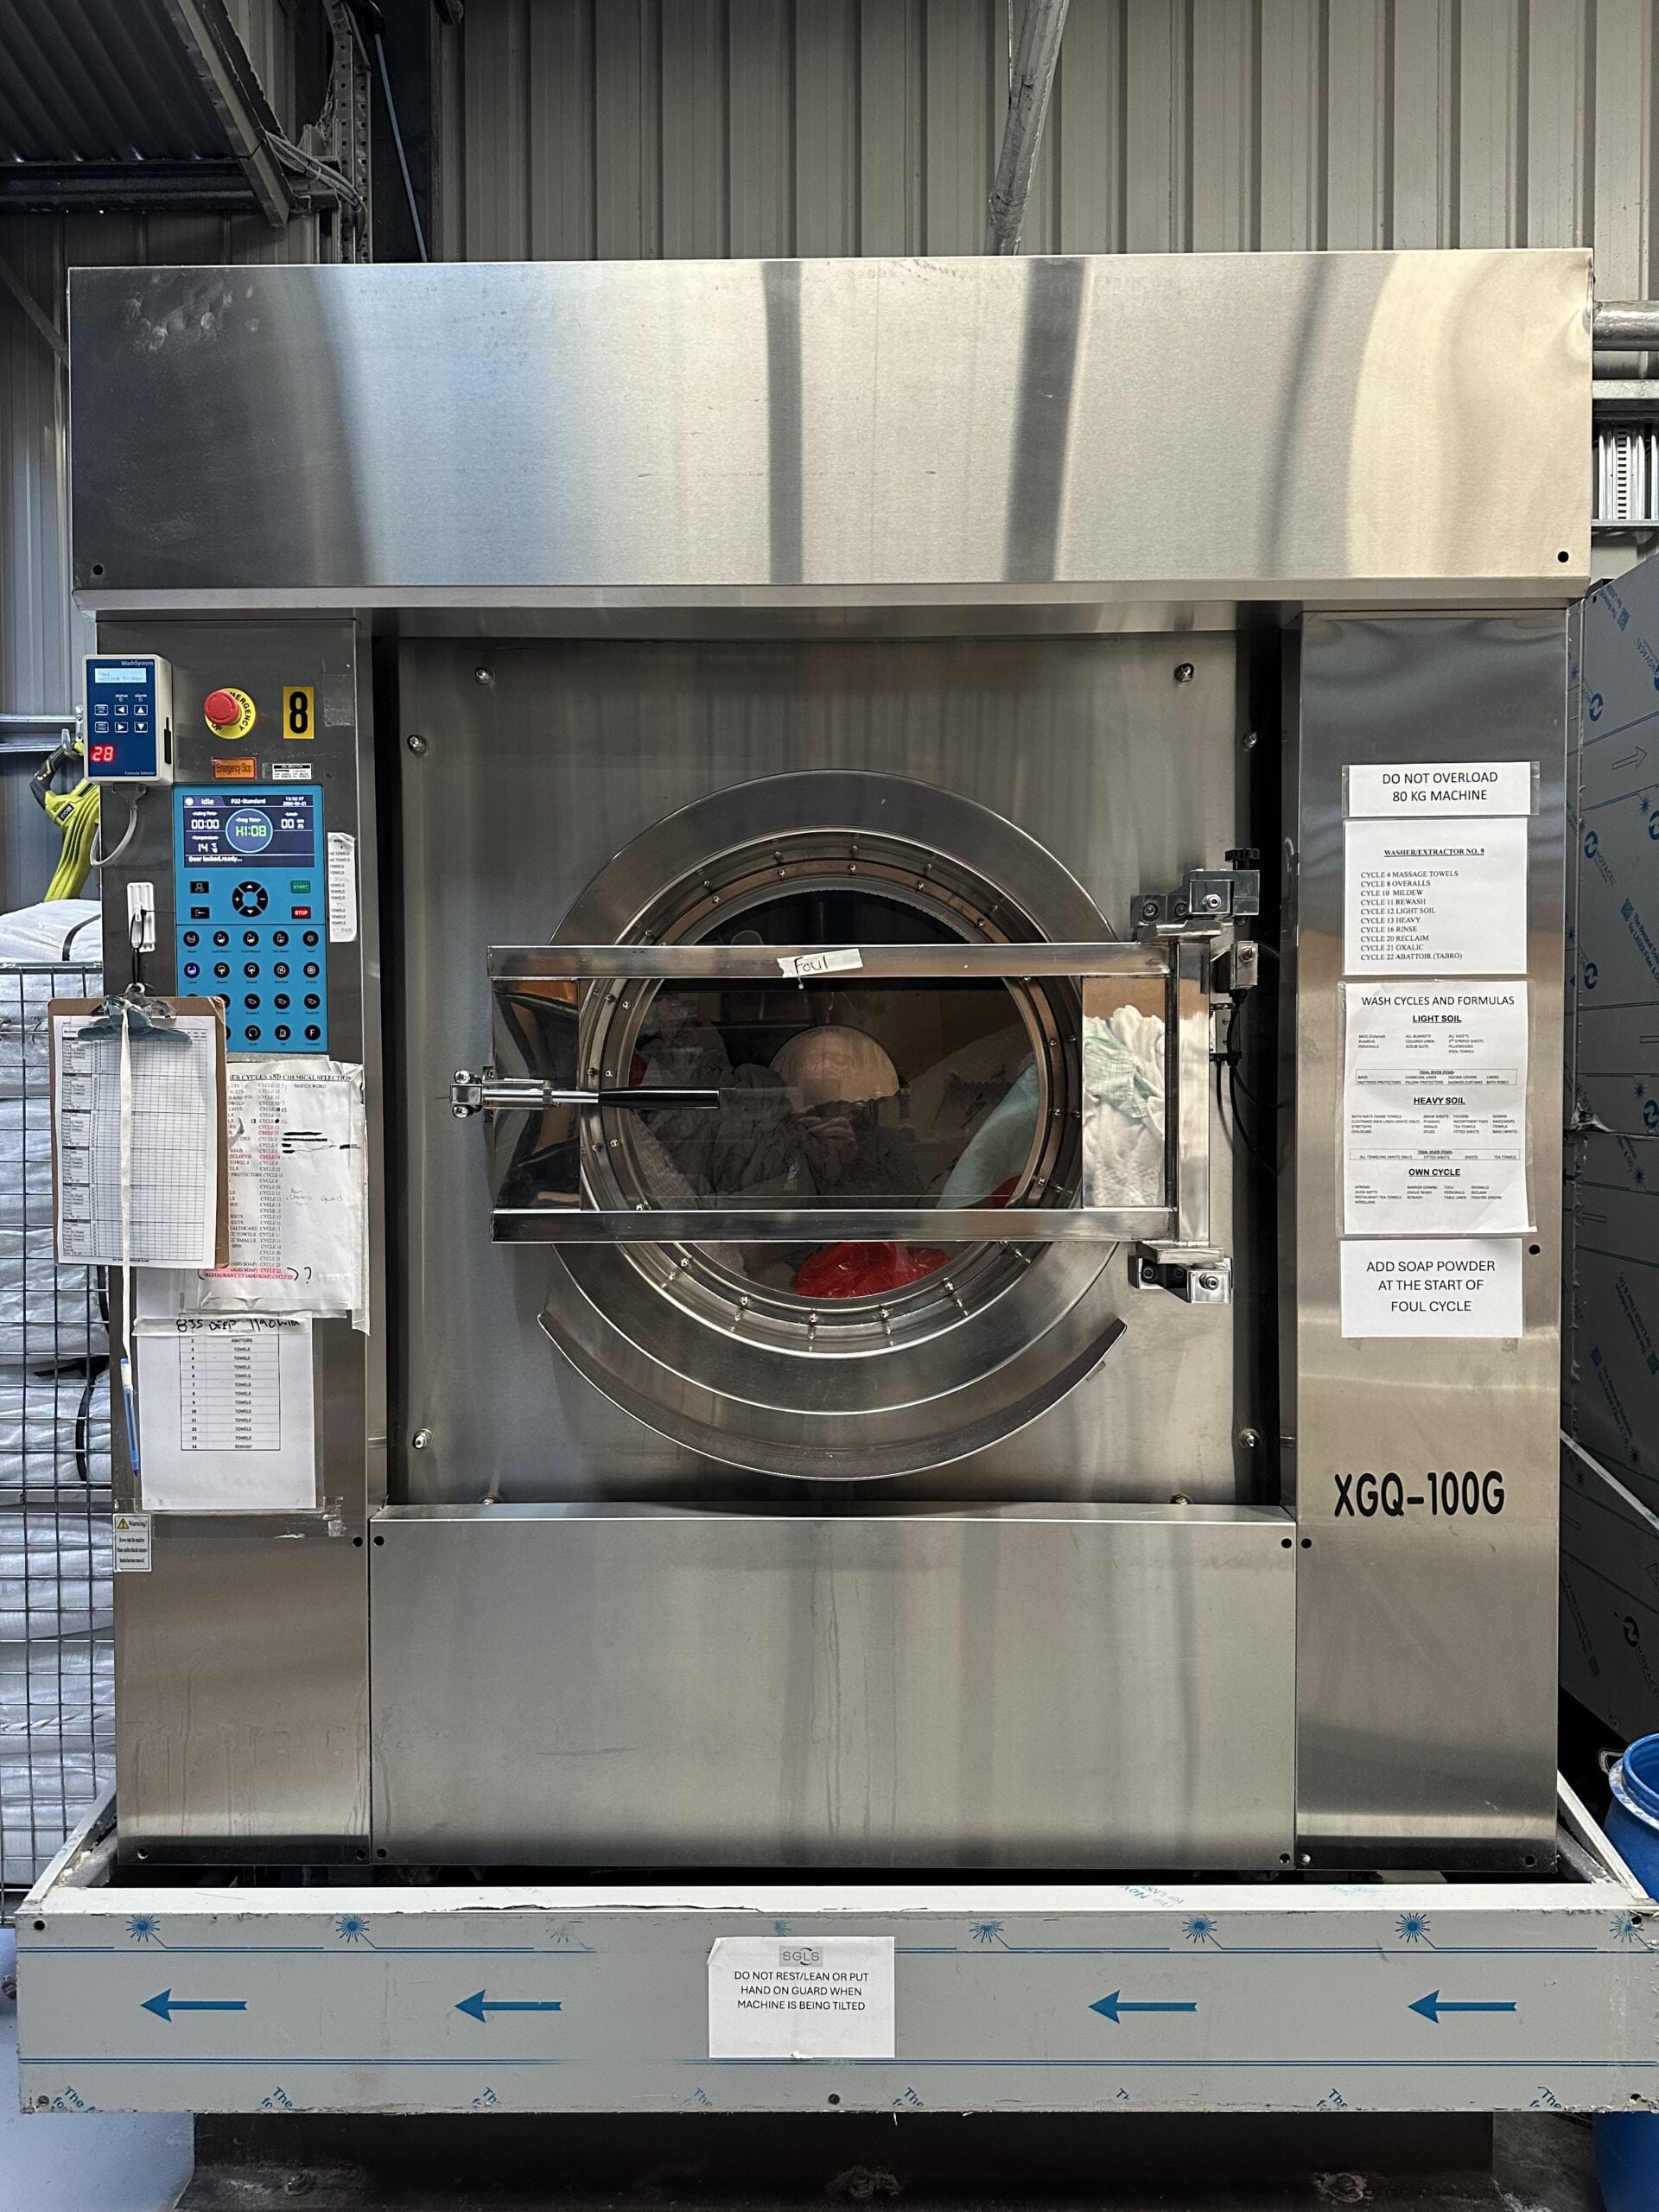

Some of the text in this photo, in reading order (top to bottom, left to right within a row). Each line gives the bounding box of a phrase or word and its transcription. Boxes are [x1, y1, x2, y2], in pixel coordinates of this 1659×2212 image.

[289, 691, 308, 734] 8
[92, 747, 113, 761] 28
[216, 763, 251, 774] Emergency Stop
[1382, 772, 1498, 785] DO NOT OVERLOAD
[1393, 790, 1488, 802] 80 KG MACHINE
[191, 819, 219, 830] 00:00
[281, 819, 295, 829] 00
[198, 843, 208, 853] 14
[794, 956, 828, 975] Foul
[1362, 996, 1514, 1006] WASH CYCLES AND FORMULAS
[1446, 1096, 1465, 1105] SOIL
[1432, 1168, 1461, 1177] CYCLE
[1366, 1261, 1496, 1272] ADD SOAP POWDER
[1378, 1280, 1484, 1290] AT THE START OF
[1391, 1301, 1471, 1312] FOUL CYCLE
[209, 1320, 237, 1331] DEEP
[1334, 1471, 1504, 1517] XGQ-100G
[783, 1951, 819, 1961] SGLS
[734, 1971, 750, 1980] DO
[777, 1972, 830, 1980] REST/LEAN
[849, 1973, 869, 1981] PUT
[830, 1987, 861, 1996] WHEN
[738, 2000, 785, 2009] MACHINE
[799, 2001, 830, 2010] BEING
[833, 2001, 865, 2010] TILTED
[65, 2086, 84, 2108] The
[273, 2086, 293, 2108] The
[1542, 2088, 1562, 2109] The
